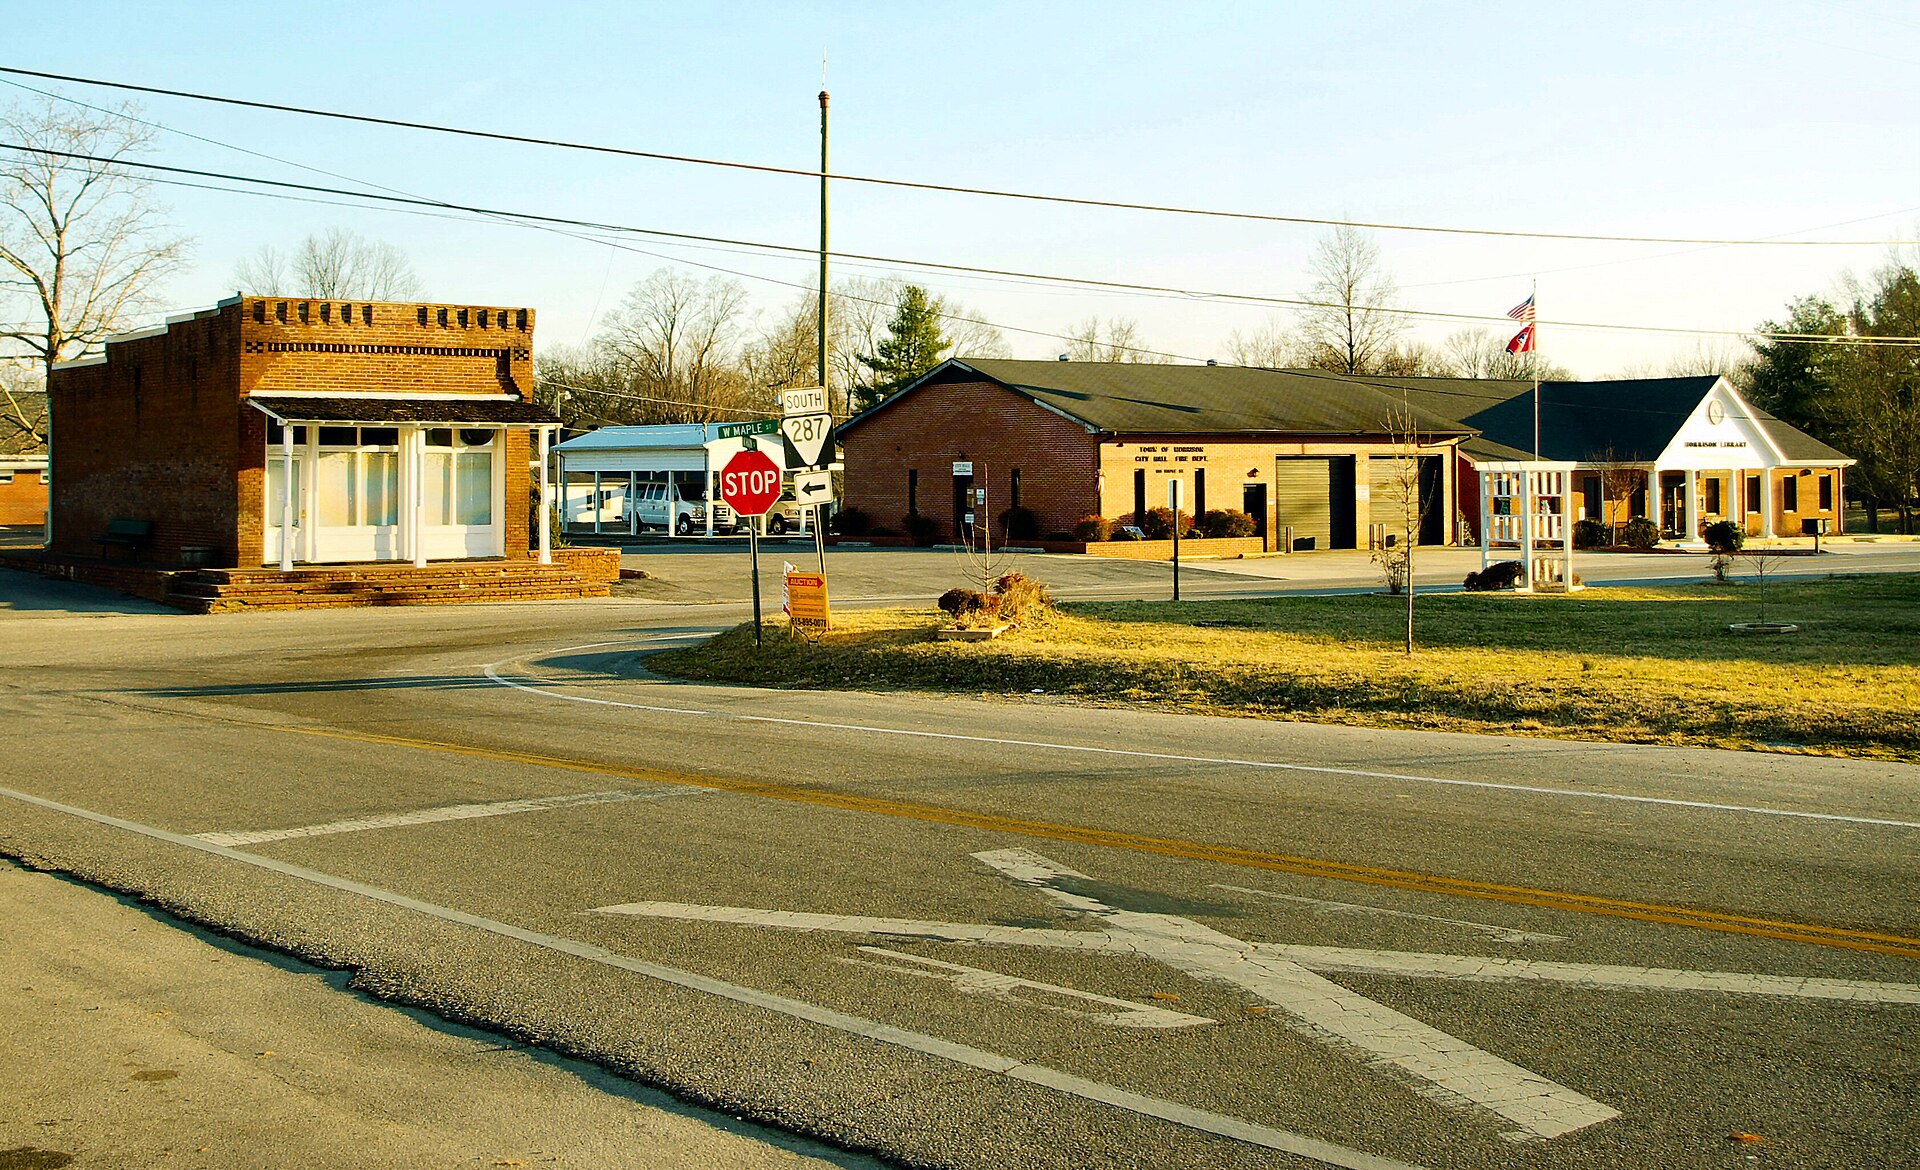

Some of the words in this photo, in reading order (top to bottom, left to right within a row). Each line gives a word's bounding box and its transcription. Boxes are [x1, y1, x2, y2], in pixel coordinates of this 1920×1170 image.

[786, 393, 823, 409] SOUTH
[722, 427, 731, 438] W
[733, 422, 763, 436] MAPLE
[791, 418, 823, 443] 287
[725, 470, 777, 497] STOP
[790, 578, 817, 586] AUCTION
